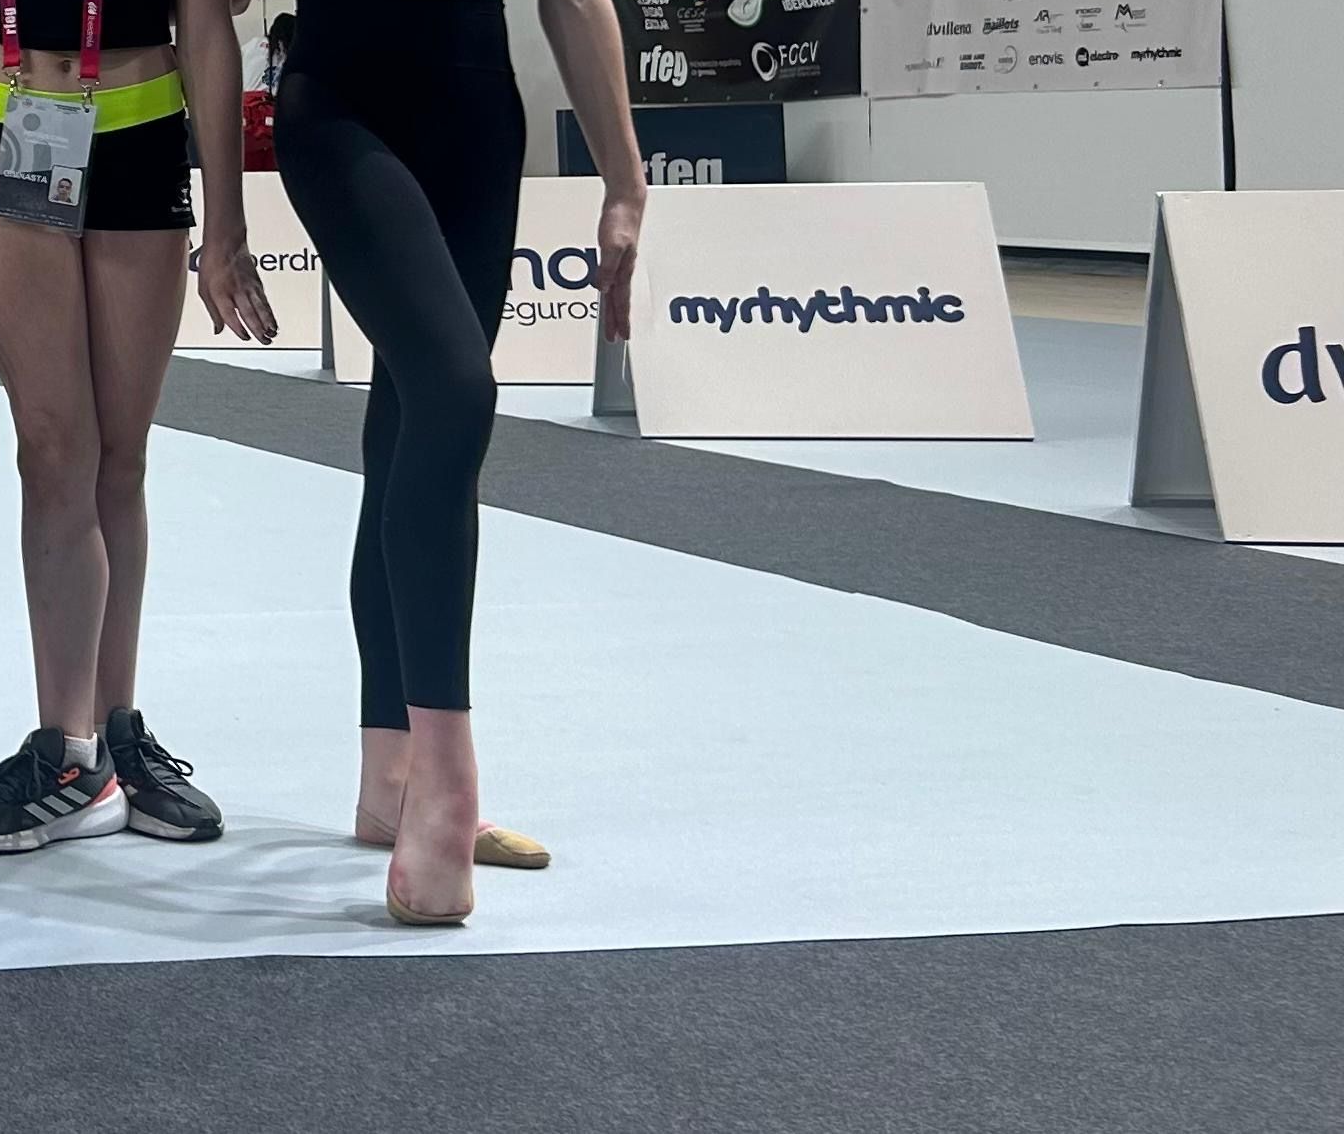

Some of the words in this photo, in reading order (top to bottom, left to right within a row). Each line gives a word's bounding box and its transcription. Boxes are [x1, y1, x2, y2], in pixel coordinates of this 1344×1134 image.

[639, 44, 688, 87] rfeg
[501, 301, 600, 326] eguros
[669, 286, 965, 333] myrhythmic
